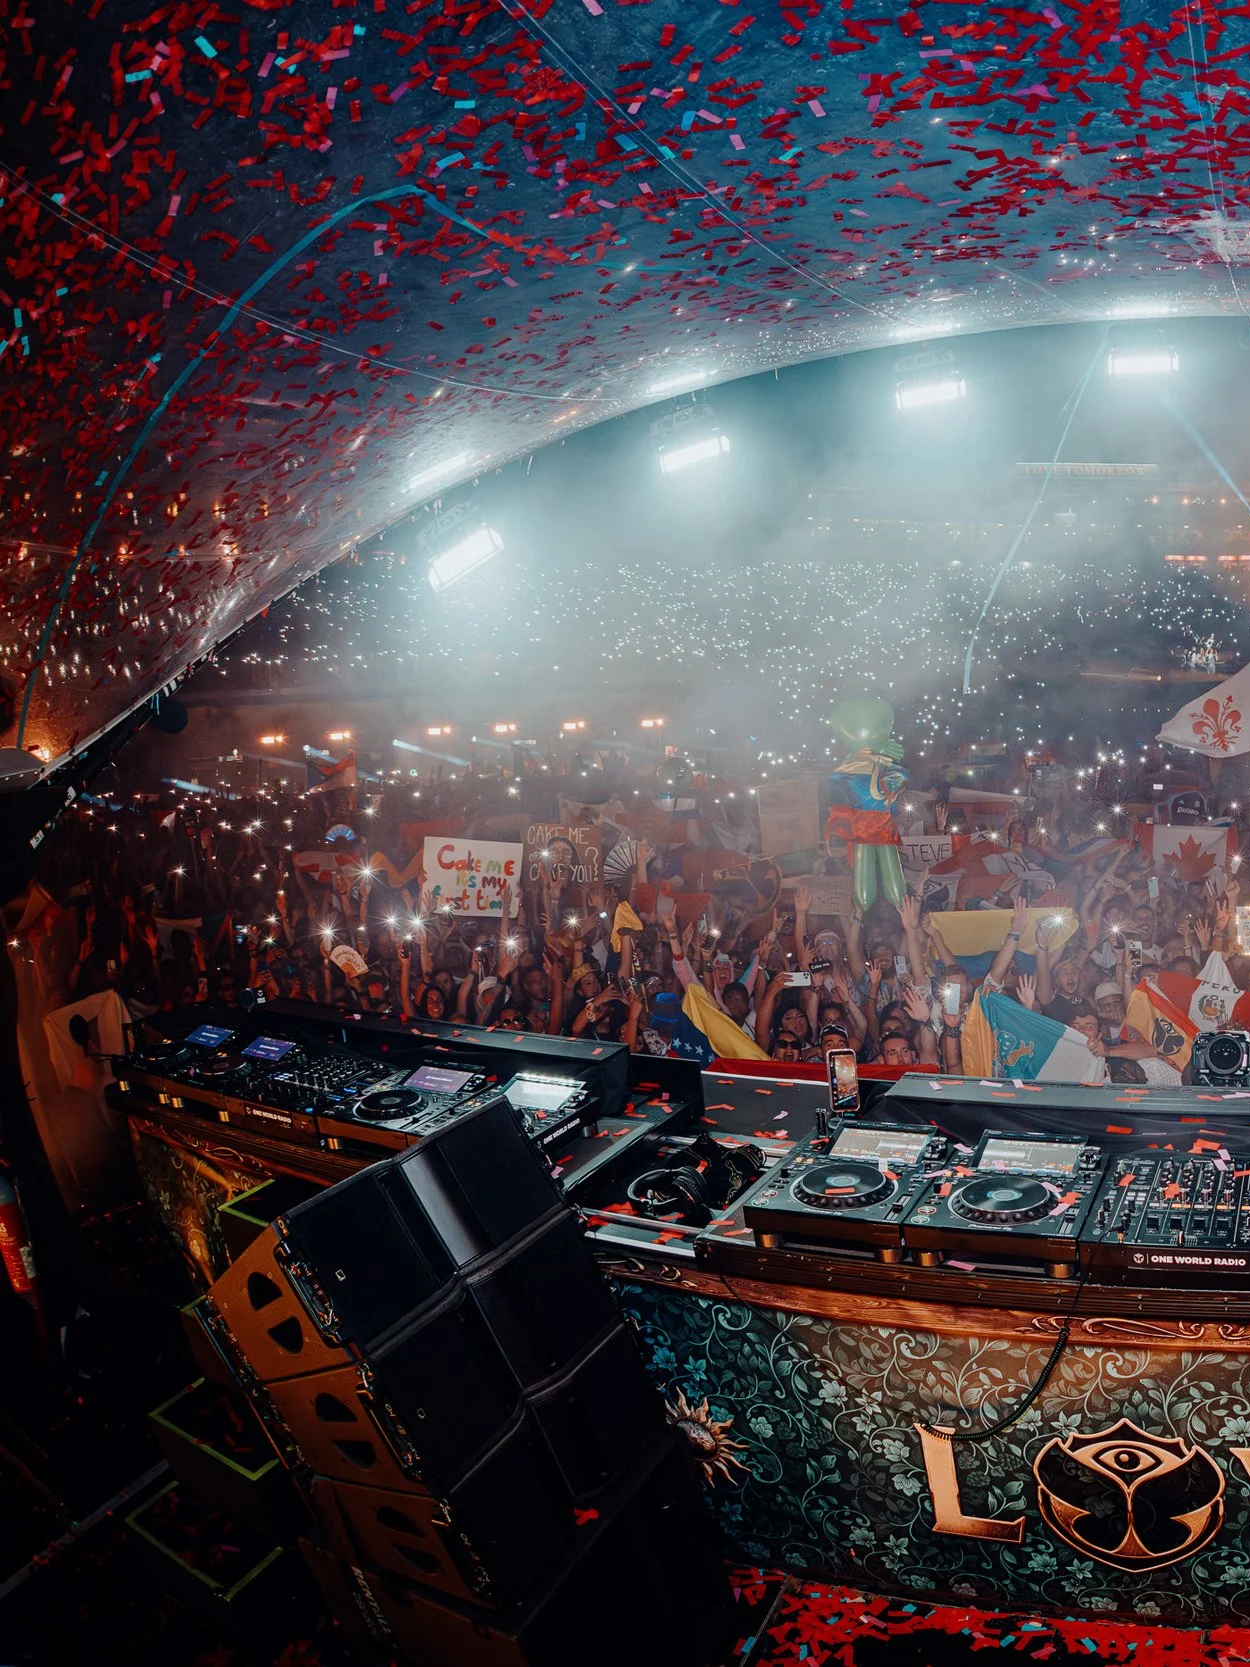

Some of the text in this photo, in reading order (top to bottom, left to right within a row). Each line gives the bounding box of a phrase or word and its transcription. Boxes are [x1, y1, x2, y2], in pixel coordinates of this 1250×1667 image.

[1067, 465, 1145, 477] TOMORROW
[568, 826, 591, 845] ME
[437, 844, 482, 873] Cake
[476, 889, 504, 911] tim
[262, 1111, 278, 1120] WORLD
[278, 1115, 291, 1123] RADIO
[543, 1118, 581, 1144] ONE WORLD RADIO
[1150, 1255, 1247, 1267] ONE WORLD RADIO
